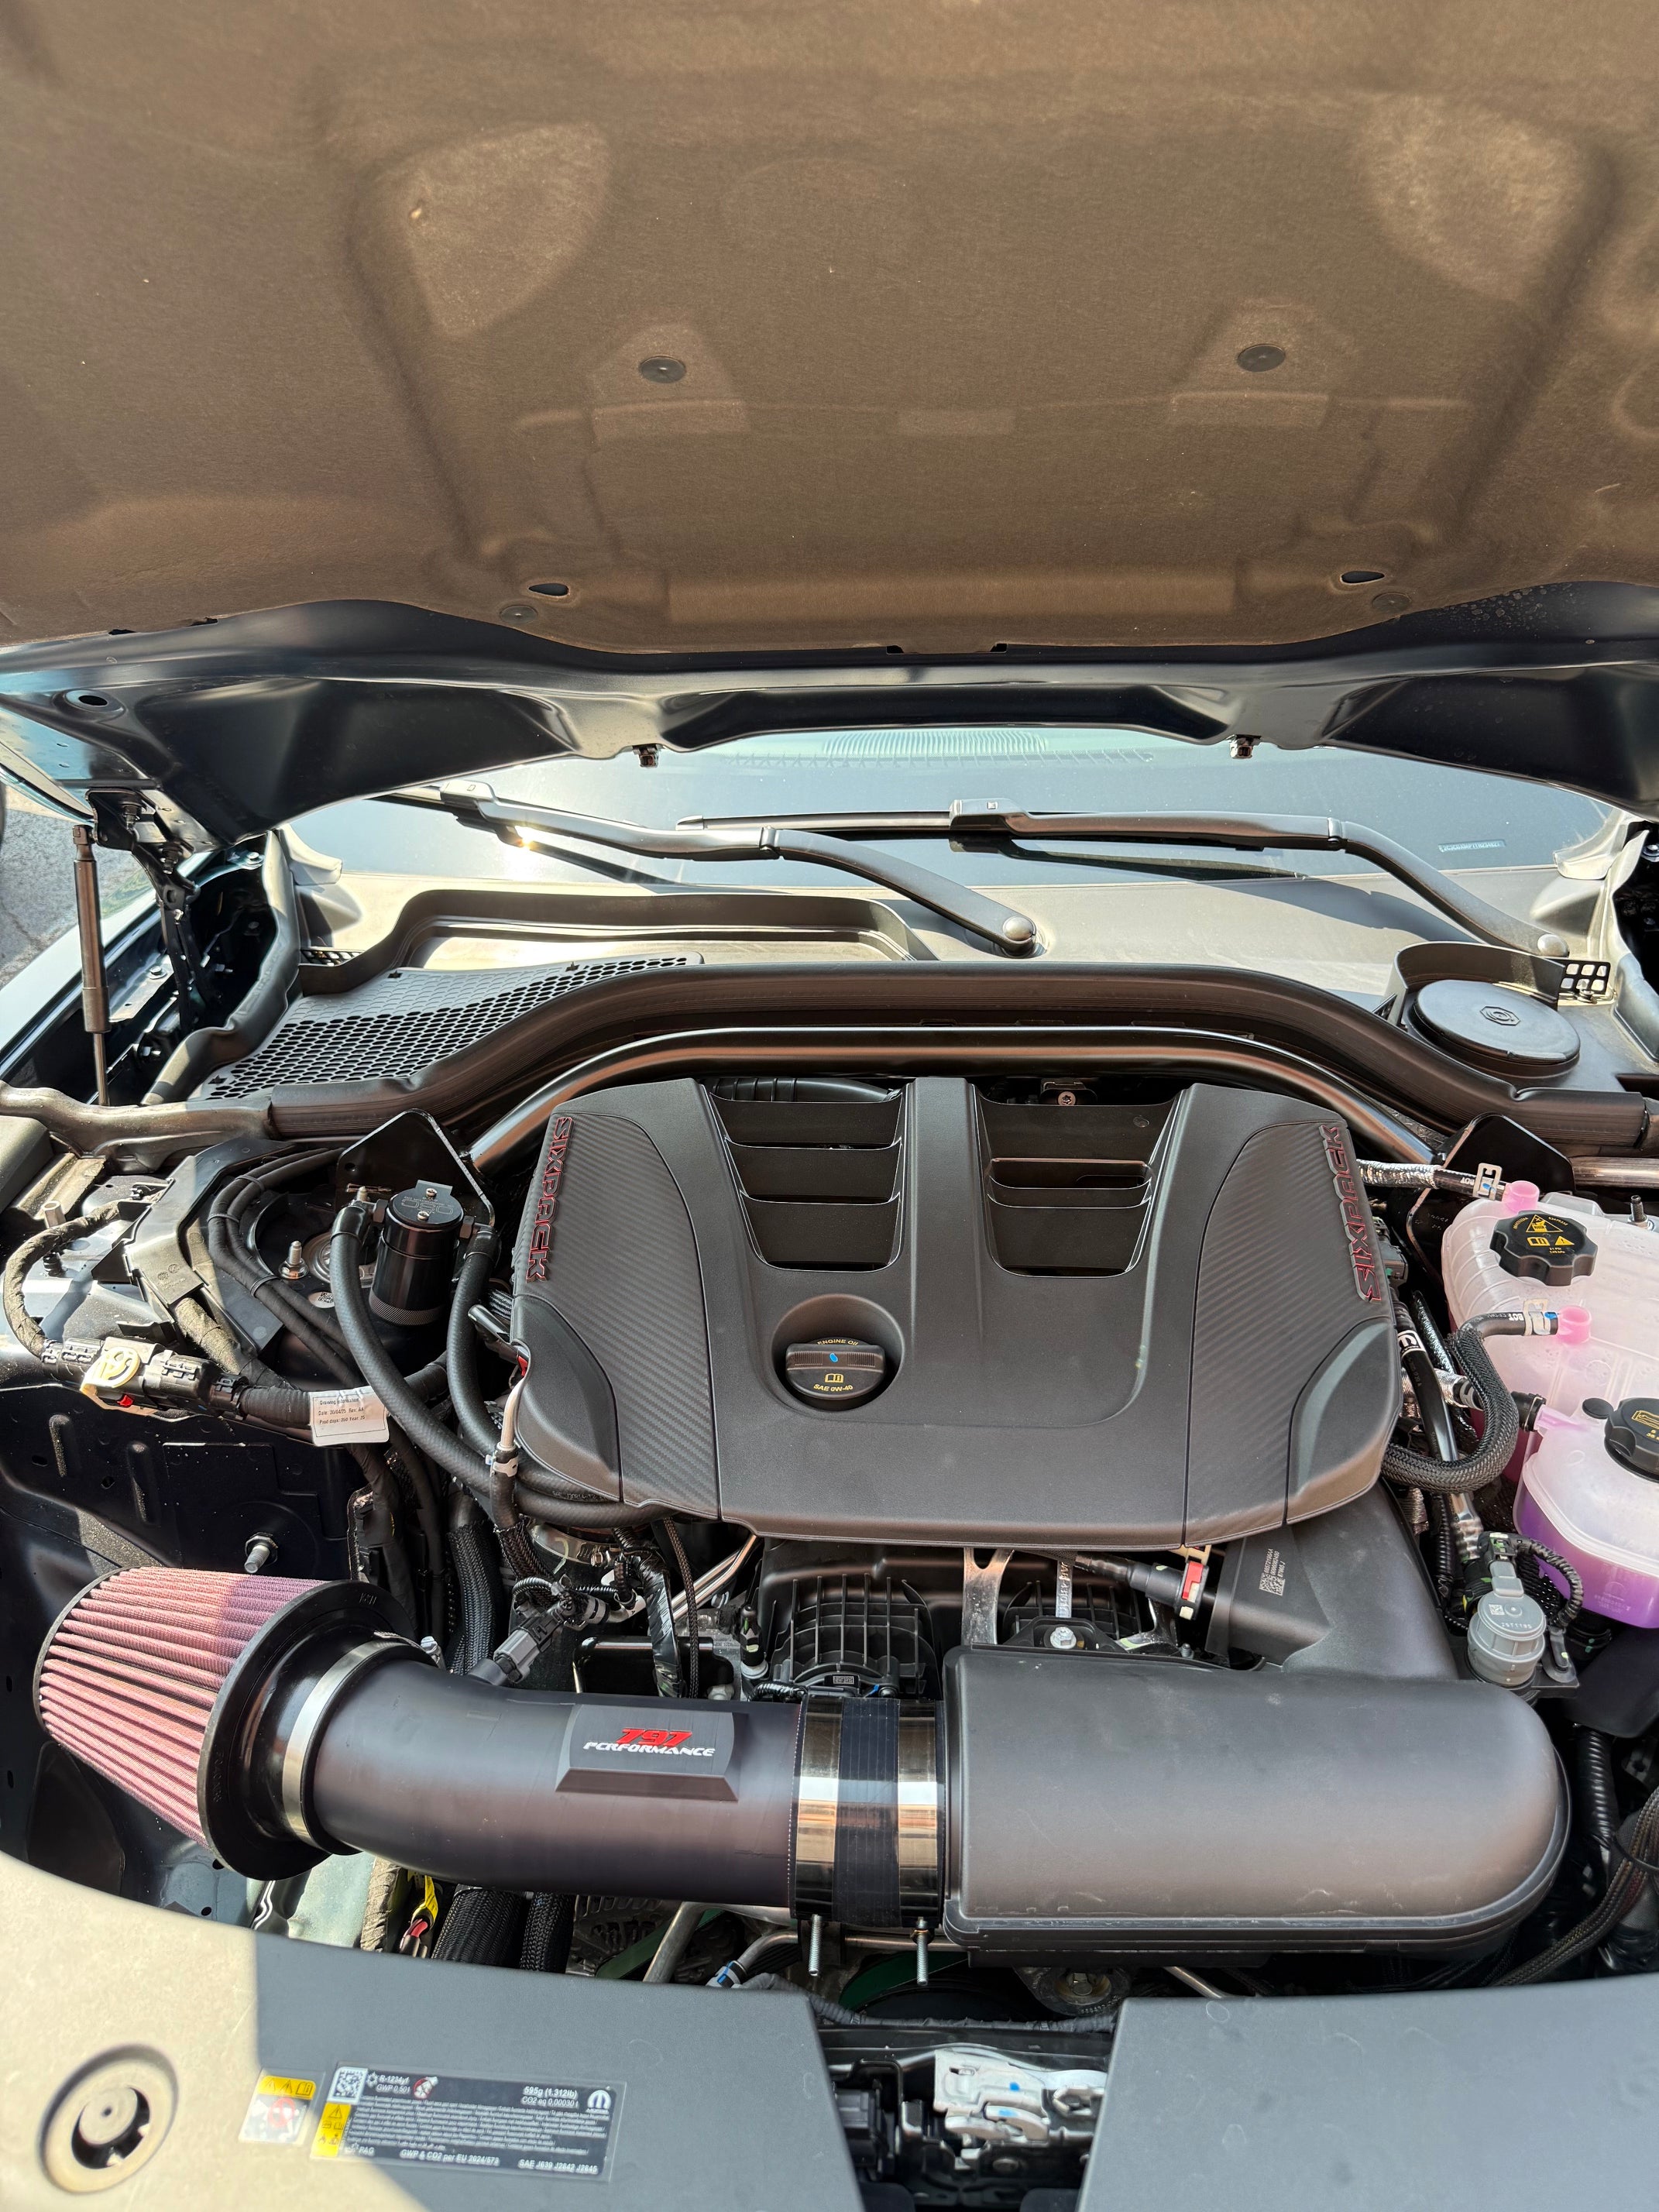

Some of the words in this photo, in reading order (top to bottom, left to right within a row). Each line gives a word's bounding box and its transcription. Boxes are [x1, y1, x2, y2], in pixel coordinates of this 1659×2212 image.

[813, 1383, 830, 1392] SAE
[582, 1741, 716, 1757] PERFORMANCE
[378, 2074, 410, 2086] R-1234yf
[376, 2083, 393, 2093] GWP
[544, 2087, 578, 2100] (1.312lb)
[521, 2096, 538, 2105] CO2
[359, 2146, 375, 2156] PAG
[400, 2148, 419, 2159] GWP
[419, 2150, 425, 2160] &
[426, 2152, 442, 2162] CO2
[442, 2154, 455, 2163] per
[455, 2154, 467, 2163] EU
[517, 2159, 535, 2169] SAE
